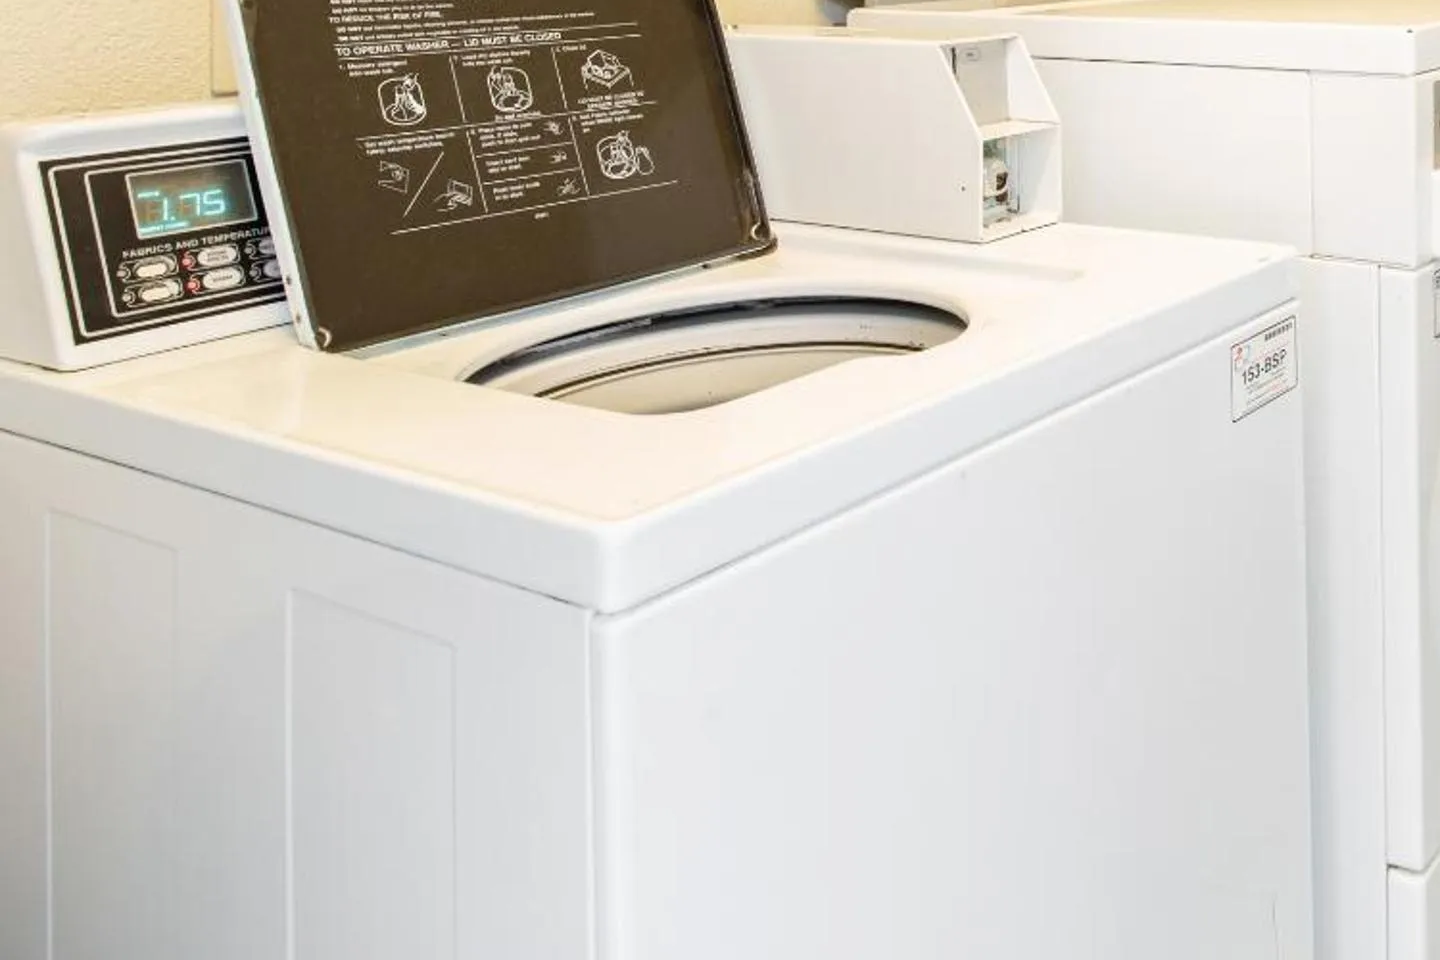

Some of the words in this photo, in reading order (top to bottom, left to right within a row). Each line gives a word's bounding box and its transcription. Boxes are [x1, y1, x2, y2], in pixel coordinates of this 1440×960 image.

[336, 47, 351, 57] TO
[352, 44, 404, 55] OPERATE
[404, 40, 450, 52] WASHER
[481, 36, 508, 46] MUST
[523, 32, 562, 42] CLOSED
[122, 244, 174, 259] FABRICS
[175, 239, 199, 251] AND
[200, 226, 271, 246] TEMPERATUR
[1241, 348, 1288, 385] 153-BSP
